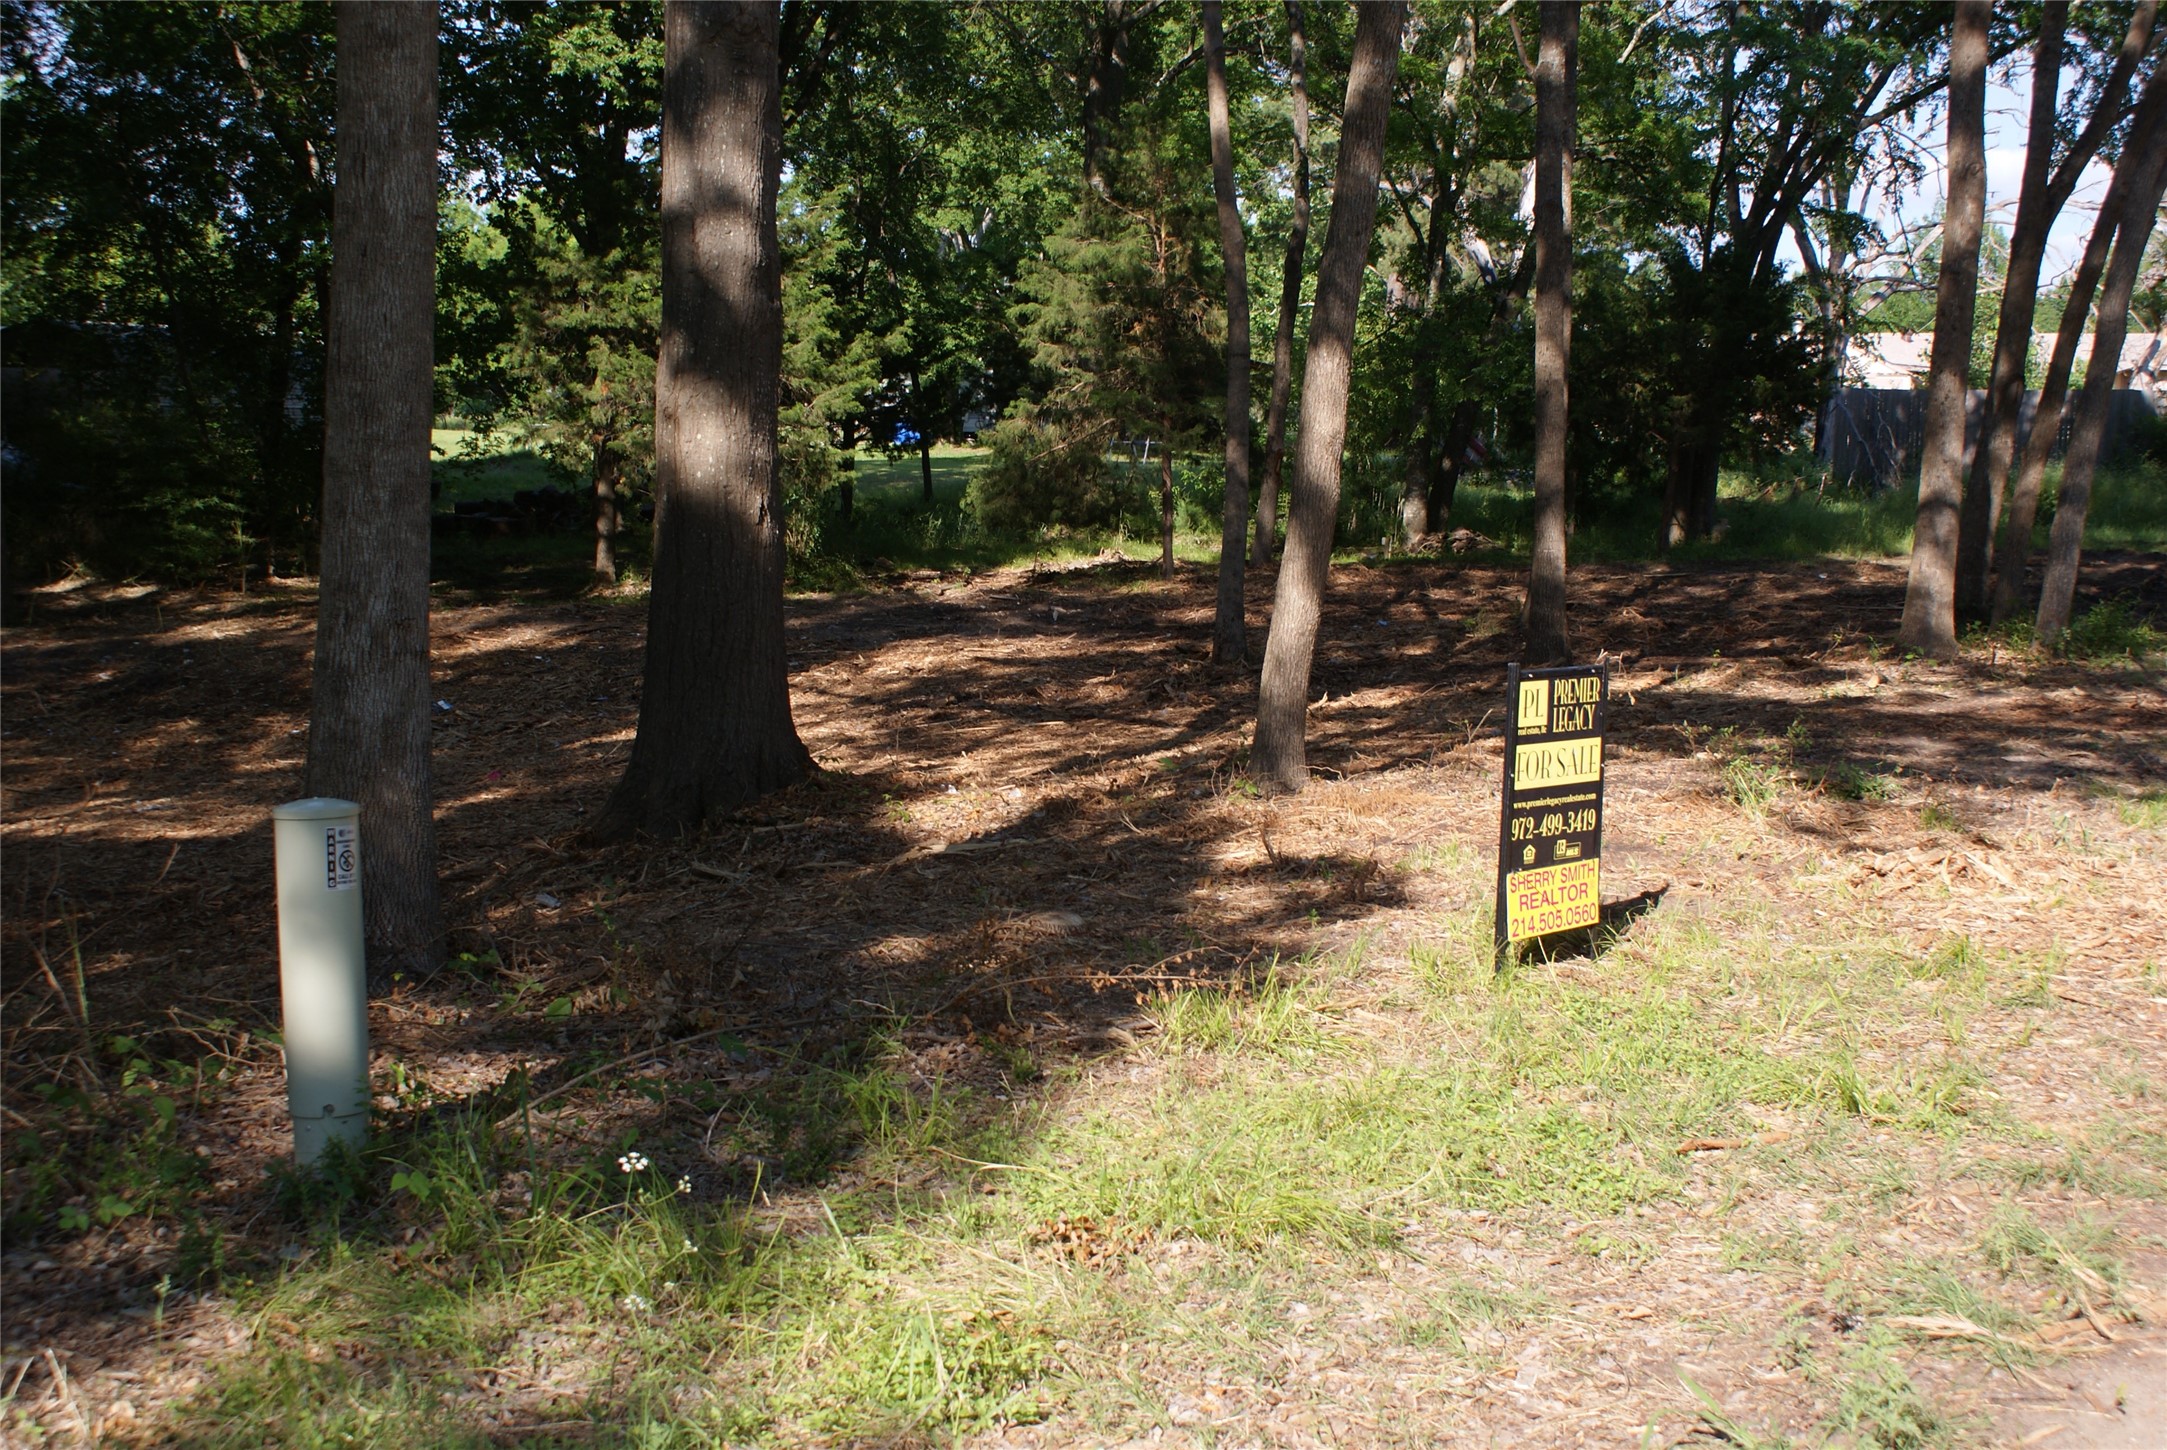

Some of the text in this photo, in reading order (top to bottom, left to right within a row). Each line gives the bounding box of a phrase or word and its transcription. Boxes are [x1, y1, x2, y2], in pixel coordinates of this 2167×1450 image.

[1523, 688, 1544, 719] PL
[1554, 677, 1600, 705] PREMIER
[1552, 704, 1596, 733] LEGACY
[1516, 744, 1599, 782] FOR SALE
[1511, 808, 1596, 841] 972-499-3419
[328, 830, 336, 886] WARNING
[1510, 861, 1595, 894] SHERRY SMITH
[1519, 882, 1588, 911] REALTOR
[1512, 902, 1597, 938] 214.505.0560
